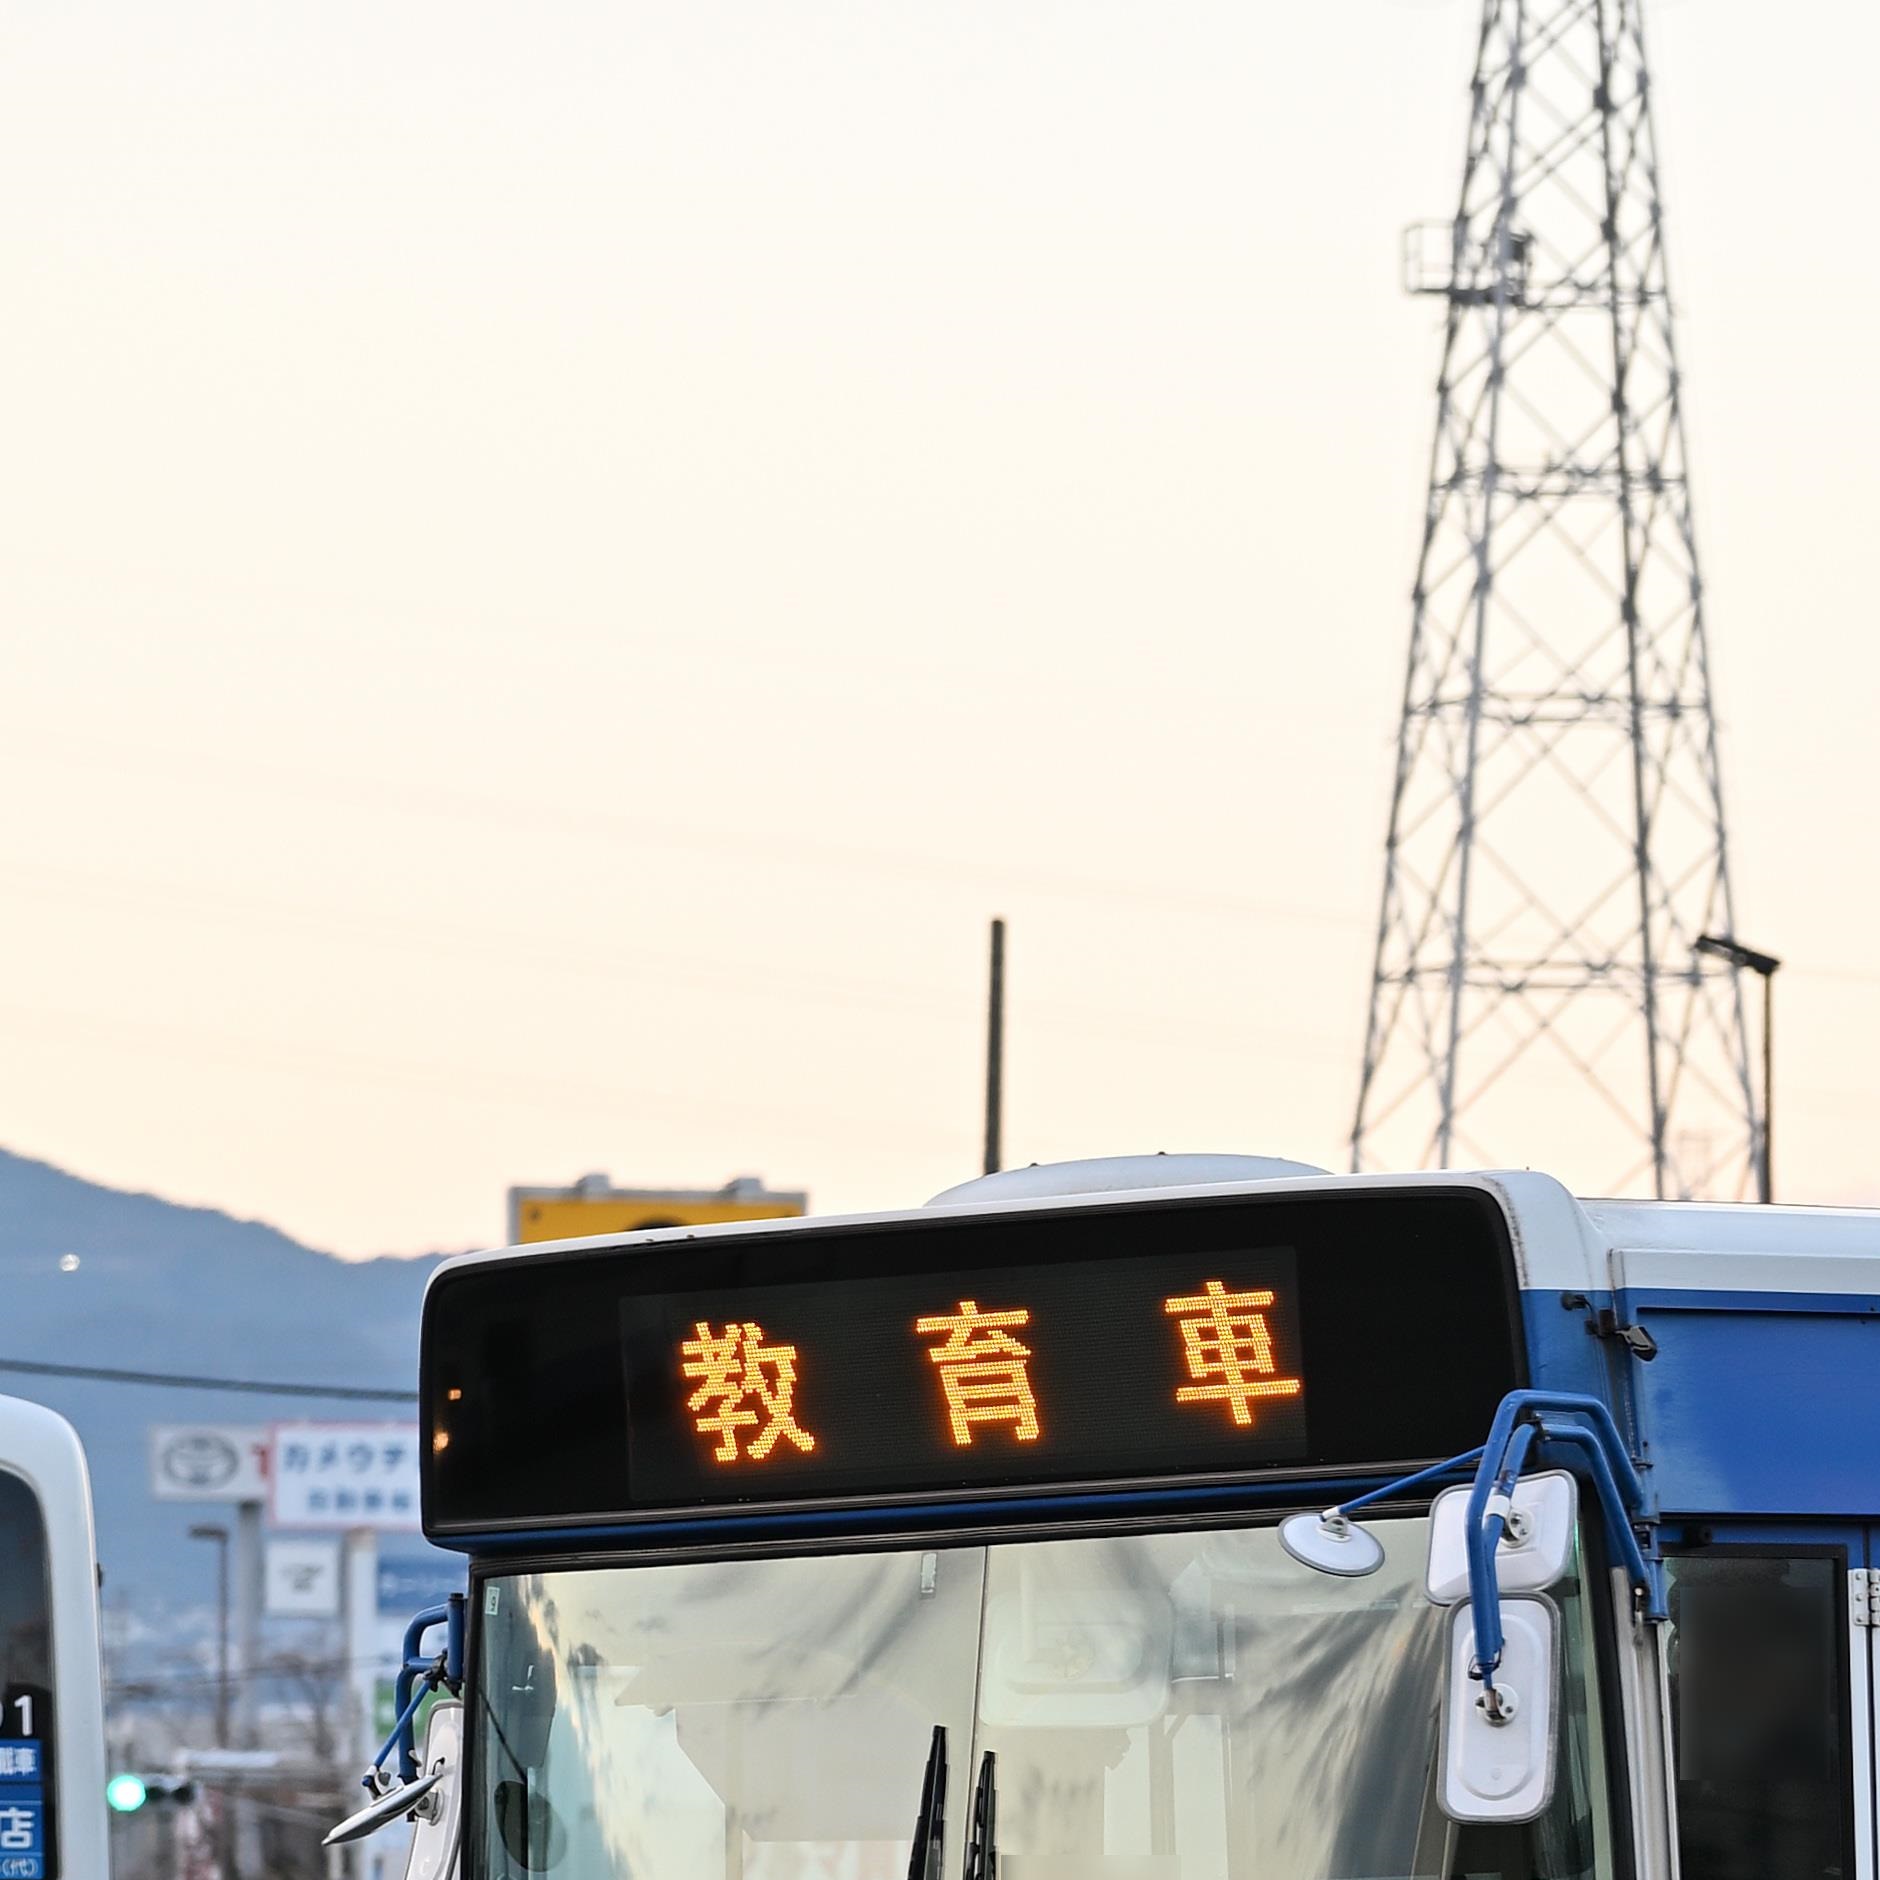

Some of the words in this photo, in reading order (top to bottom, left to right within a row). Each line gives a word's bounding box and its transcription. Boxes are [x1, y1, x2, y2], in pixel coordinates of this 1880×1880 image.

[682, 1281, 1300, 1463] 教育車
[0, 1694, 34, 1736] 1
